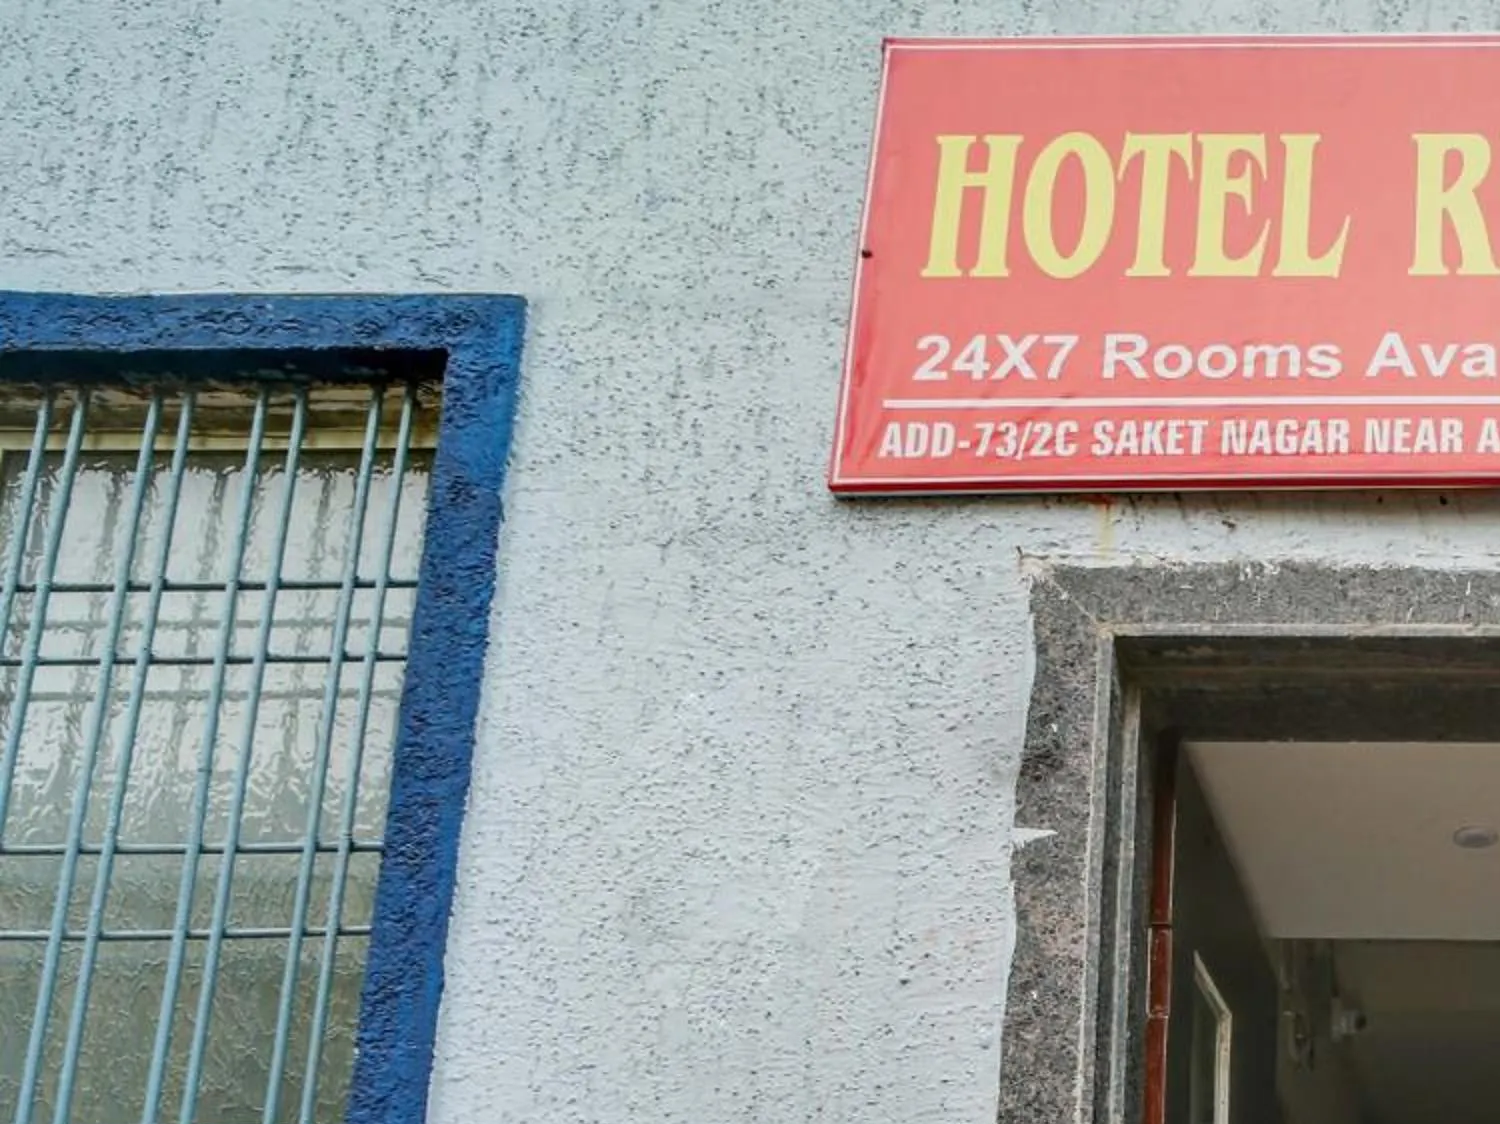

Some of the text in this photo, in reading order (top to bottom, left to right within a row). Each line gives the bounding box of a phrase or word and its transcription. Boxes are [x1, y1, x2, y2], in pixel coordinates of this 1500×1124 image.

[920, 132, 1351, 278] HOTEL
[912, 334, 1079, 381] 24X7
[1101, 332, 1342, 380] Rooms
[879, 420, 1079, 460] ADD-73/2C
[1091, 419, 1208, 458] SAKET
[1220, 418, 1350, 457] NAGAR
[1362, 418, 1463, 455] NEAR
